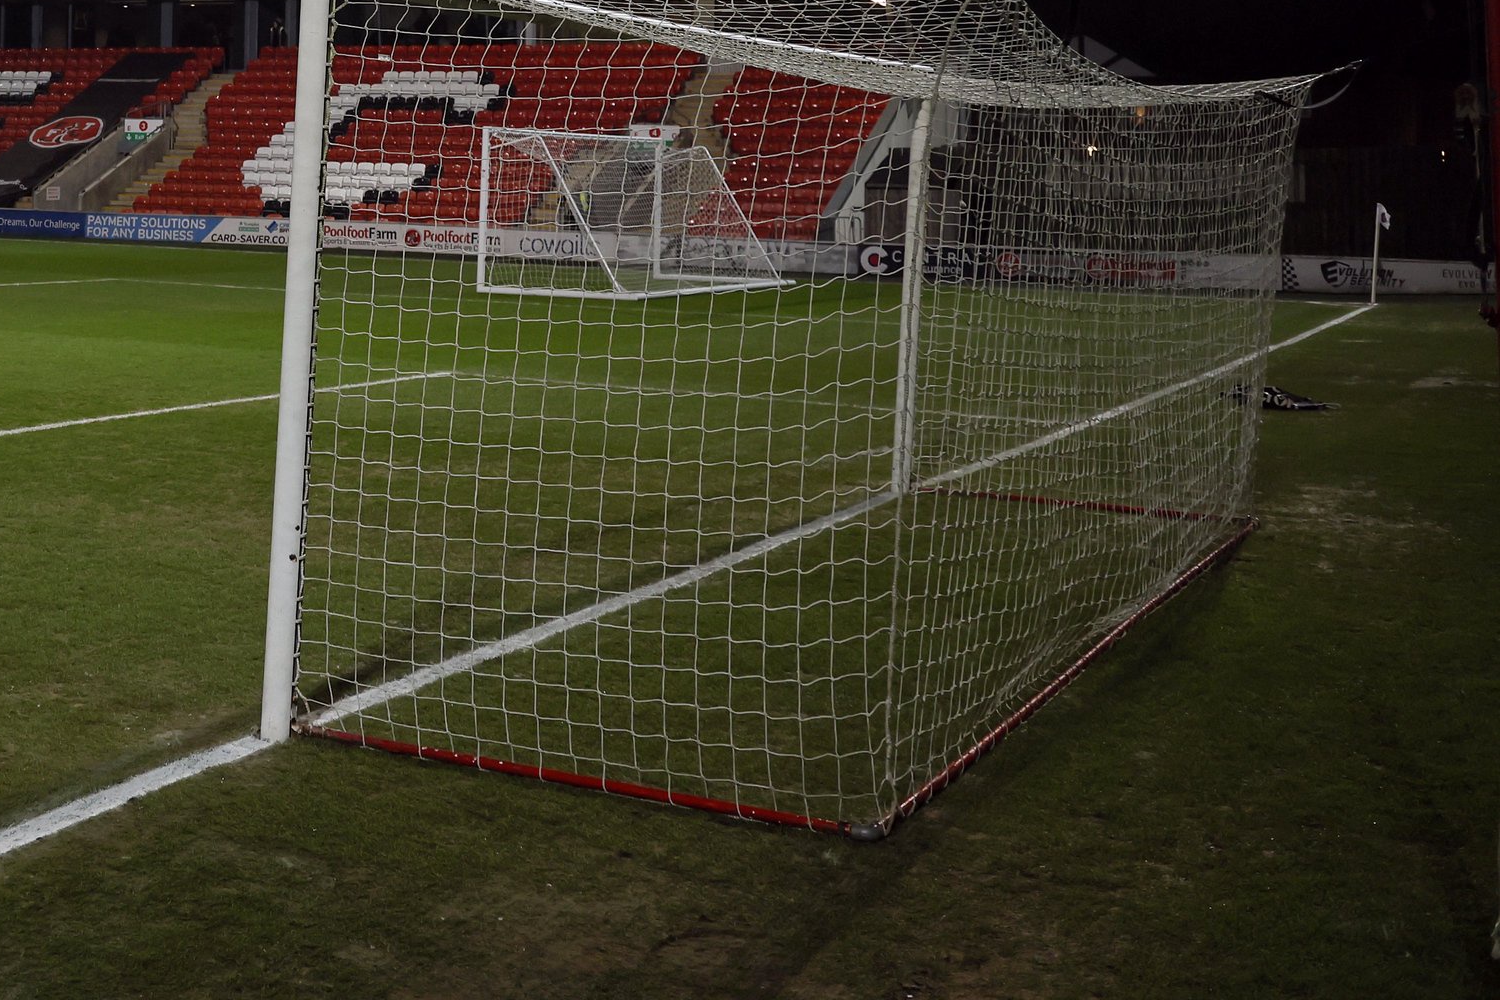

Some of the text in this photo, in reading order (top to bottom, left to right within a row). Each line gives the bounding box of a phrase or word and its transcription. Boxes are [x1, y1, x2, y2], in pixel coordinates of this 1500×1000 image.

[29, 217, 42, 227] Our
[43, 218, 80, 232] Challenge
[87, 214, 207, 230] PAYMENT SOLUTIONS
[86, 226, 194, 241] FOR ANY BUSINESS
[211, 233, 289, 245] CARD-SAVER.CO.
[323, 225, 397, 240] PoolfootFarm
[423, 230, 501, 245] PoolfootFrm
[1350, 276, 1406, 288] SECRITY
